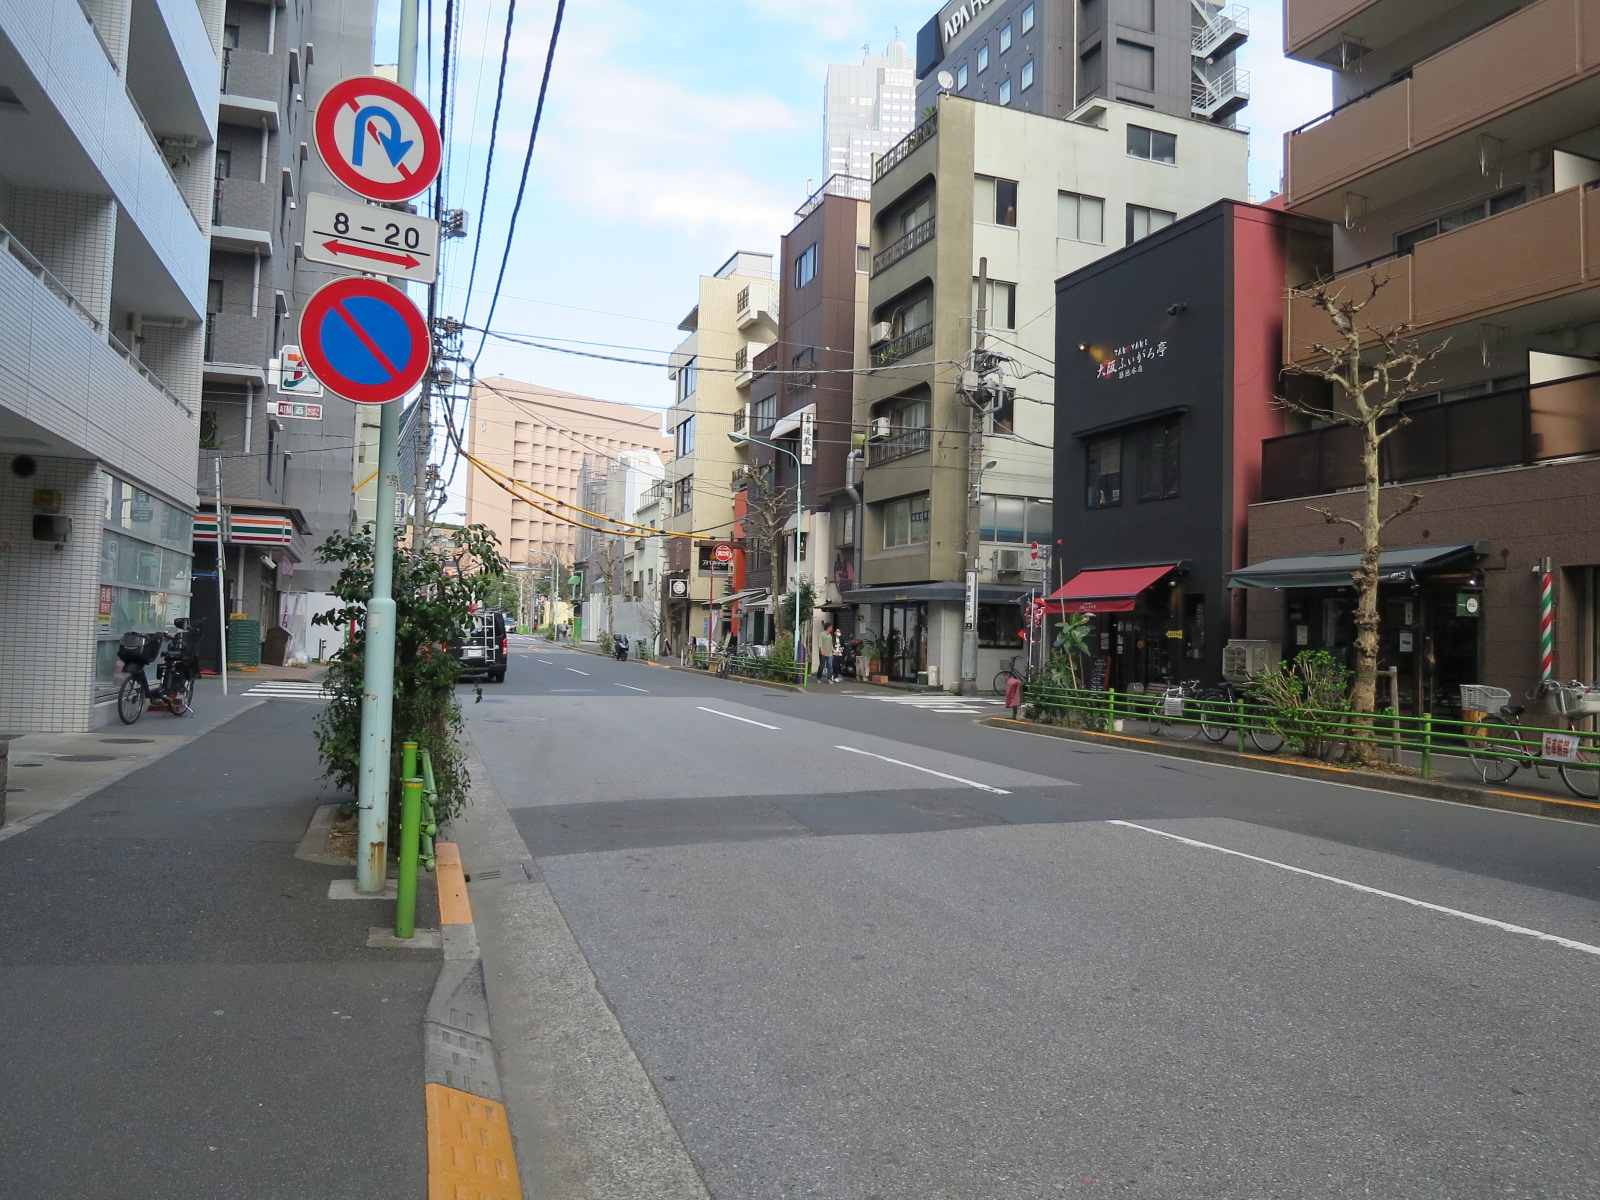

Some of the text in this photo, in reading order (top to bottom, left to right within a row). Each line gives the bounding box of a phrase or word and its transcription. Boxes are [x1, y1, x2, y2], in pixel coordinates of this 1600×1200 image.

[944, 4, 971, 44] APA
[279, 404, 292, 414] ATM
[802, 414, 813, 457] 書道教室
